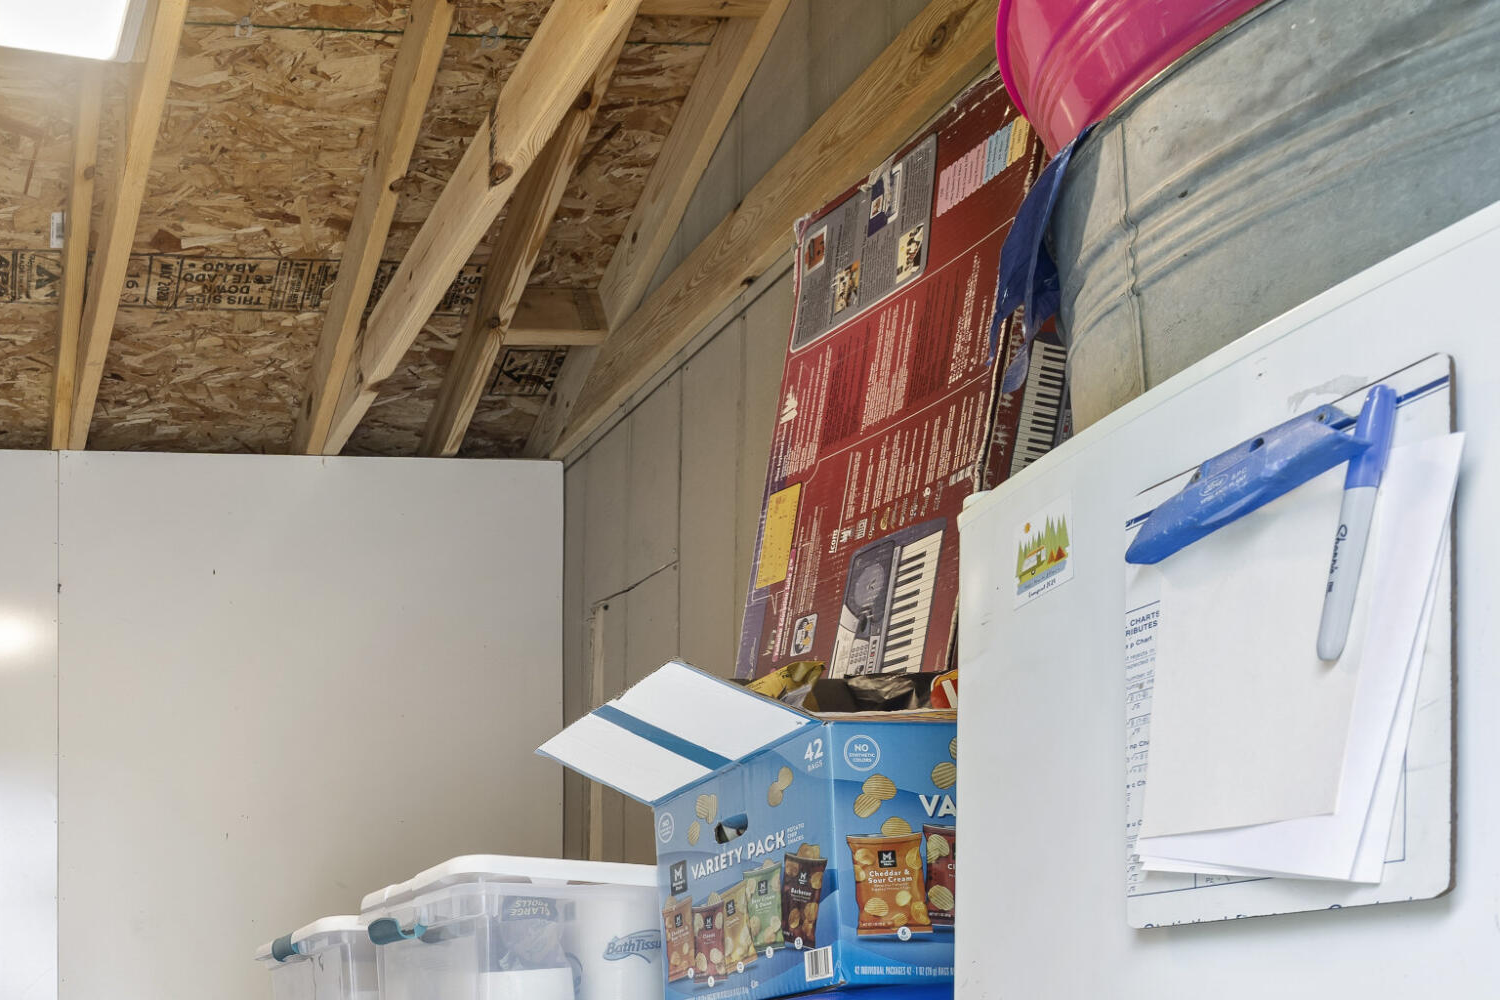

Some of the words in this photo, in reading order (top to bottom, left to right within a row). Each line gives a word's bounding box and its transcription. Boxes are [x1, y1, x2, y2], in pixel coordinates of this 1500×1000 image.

[202, 262, 259, 274] ABAJO
[181, 272, 227, 284] LADO
[201, 284, 251, 295] DOWN
[184, 294, 222, 306] SIDE
[223, 295, 263, 306] THIS
[1330, 524, 1348, 574] Sharpie
[1129, 610, 1160, 627] CHARTS
[1125, 620, 1158, 637] RIBUTES
[1135, 635, 1153, 646] Chart
[803, 738, 825, 762] 42
[854, 743, 869, 752] NO
[918, 794, 957, 817] VA
[691, 845, 745, 880] VARIETY
[747, 829, 787, 859] PACK
[868, 869, 902, 877] Cheddar
[867, 876, 887, 884] Sour
[888, 875, 913, 883] Cream
